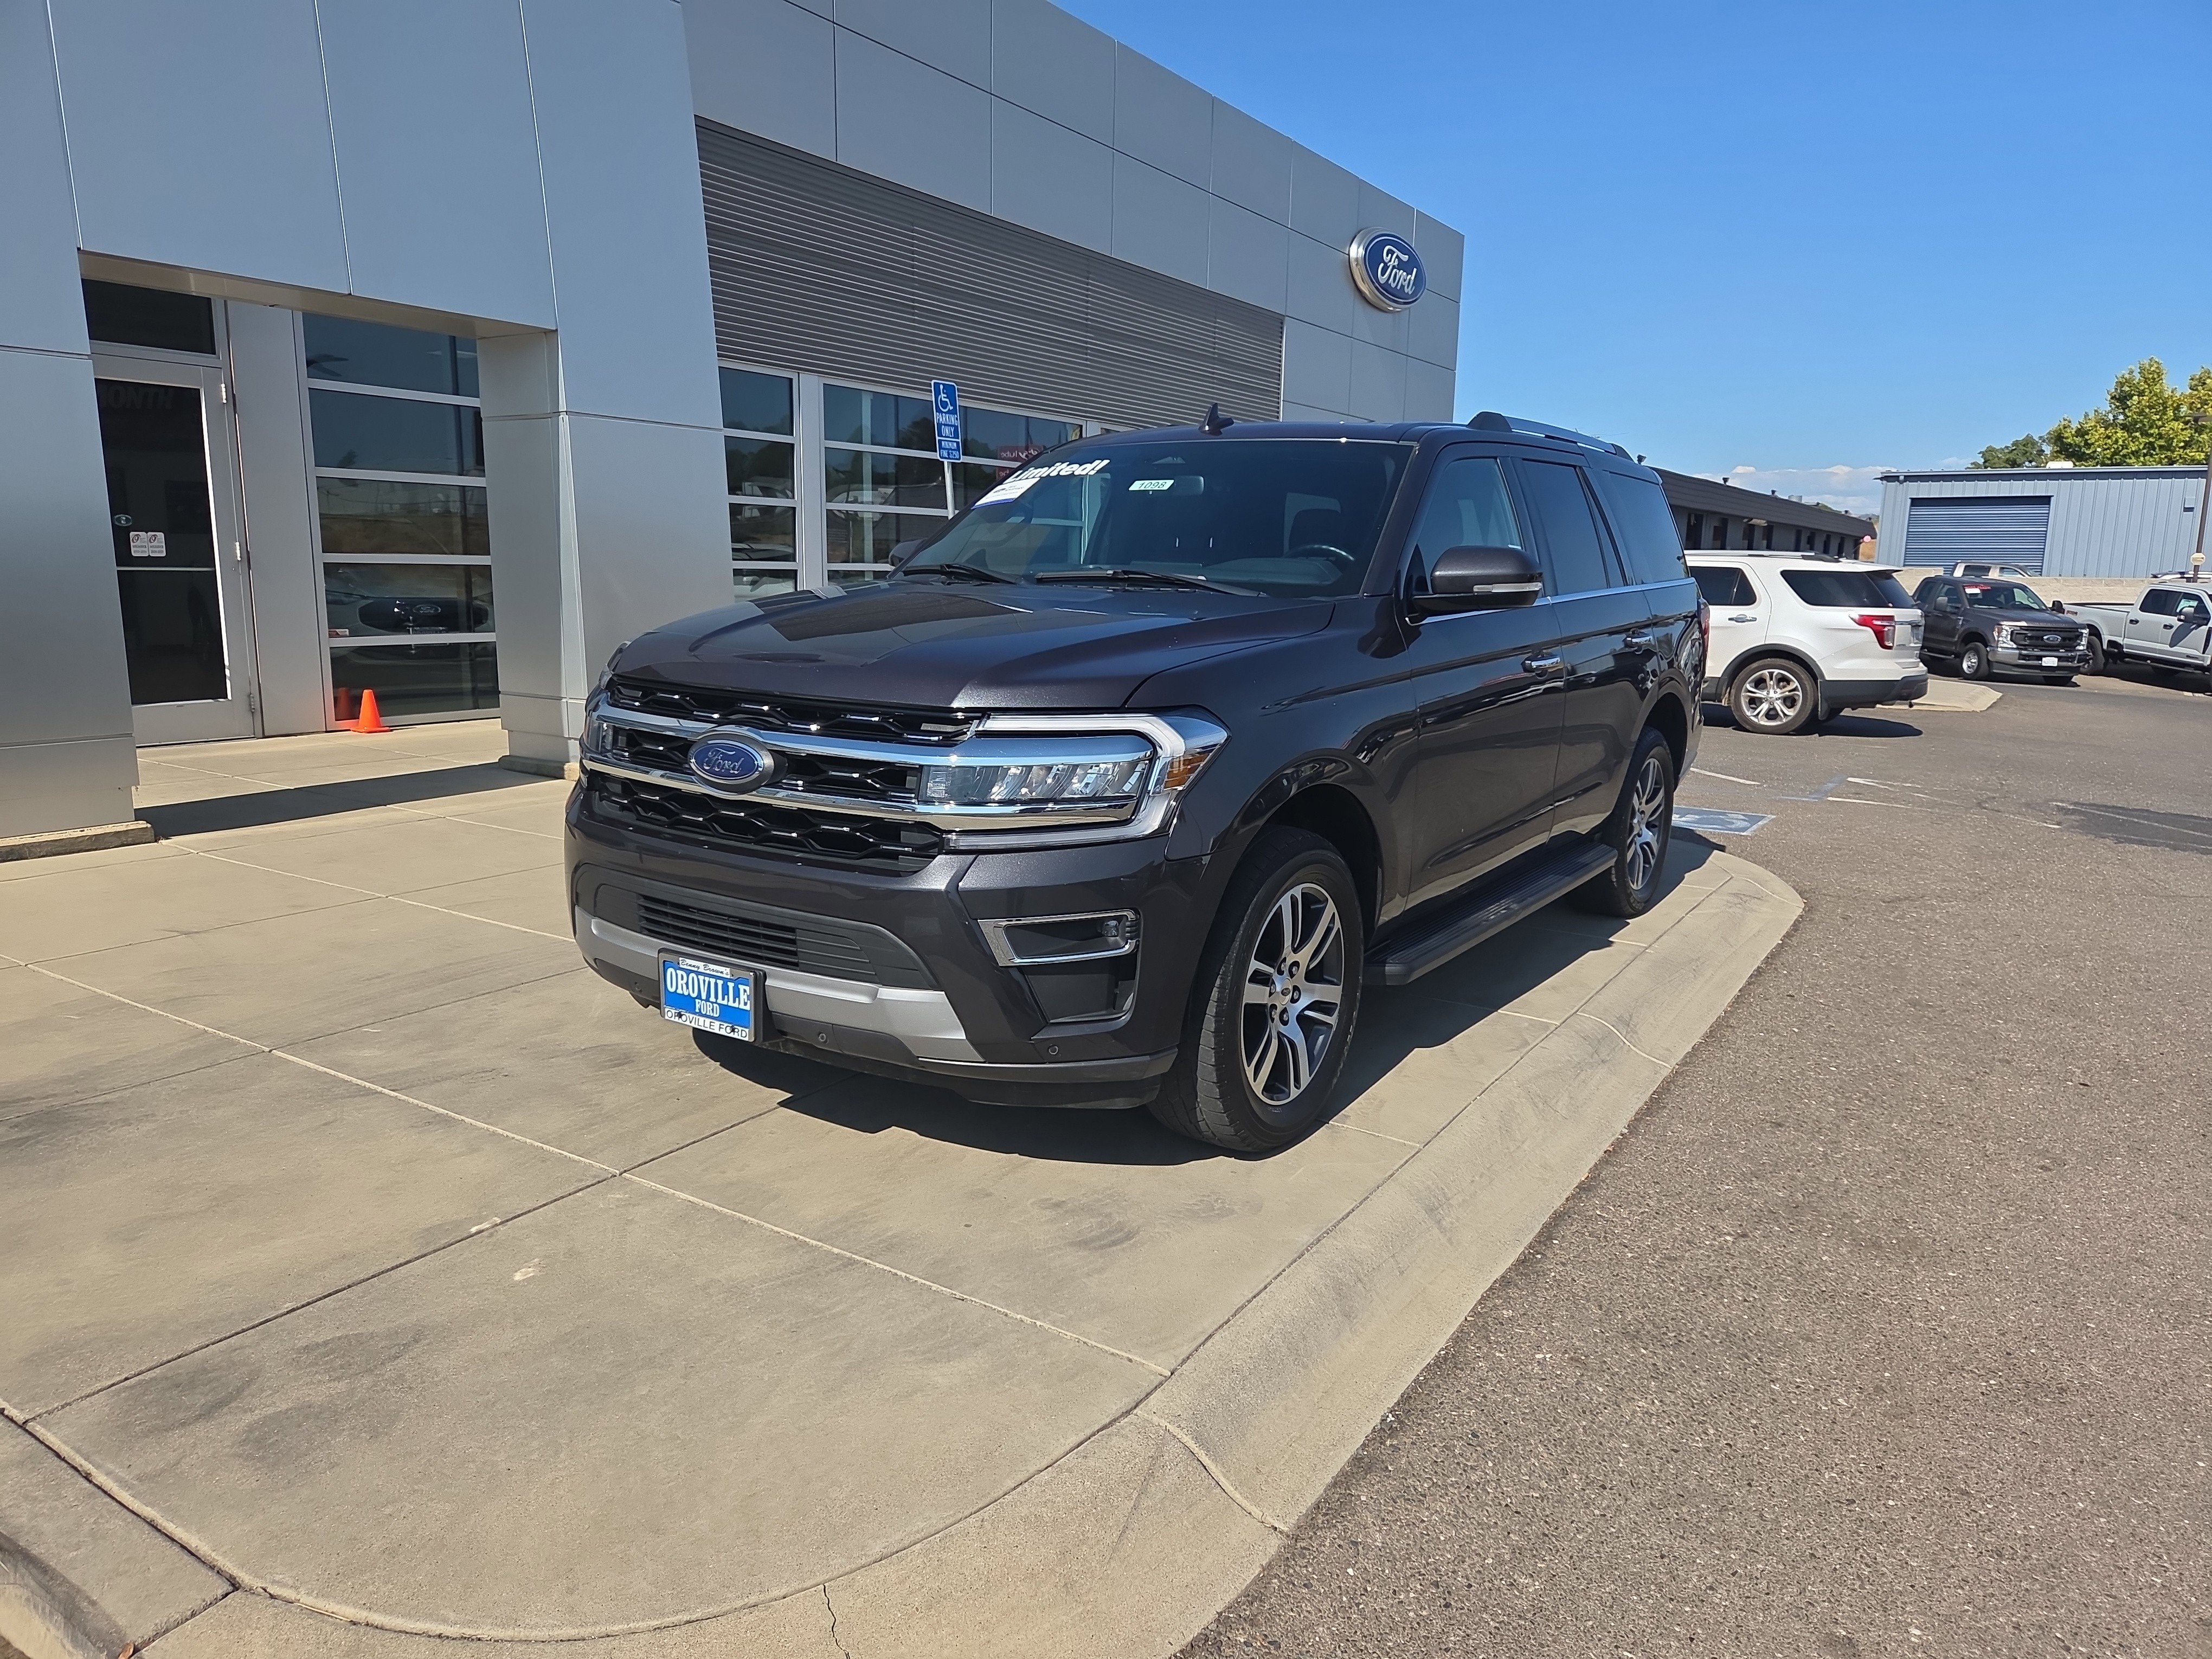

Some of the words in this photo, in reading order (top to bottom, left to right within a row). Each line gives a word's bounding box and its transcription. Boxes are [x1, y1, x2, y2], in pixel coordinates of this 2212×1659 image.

[1377, 245, 1418, 295] Ford
[936, 412, 958, 426] PARKING
[941, 426, 954, 438] ONLY
[1002, 459, 1110, 484] Limited!
[703, 748, 744, 774] Ford
[680, 959, 700, 971] Benny
[703, 964, 729, 976] Brown's
[666, 967, 750, 1011] OROVILLE
[695, 999, 720, 1018] FORD
[666, 1009, 716, 1031] OROVILLE
[719, 1023, 748, 1039] FORD
